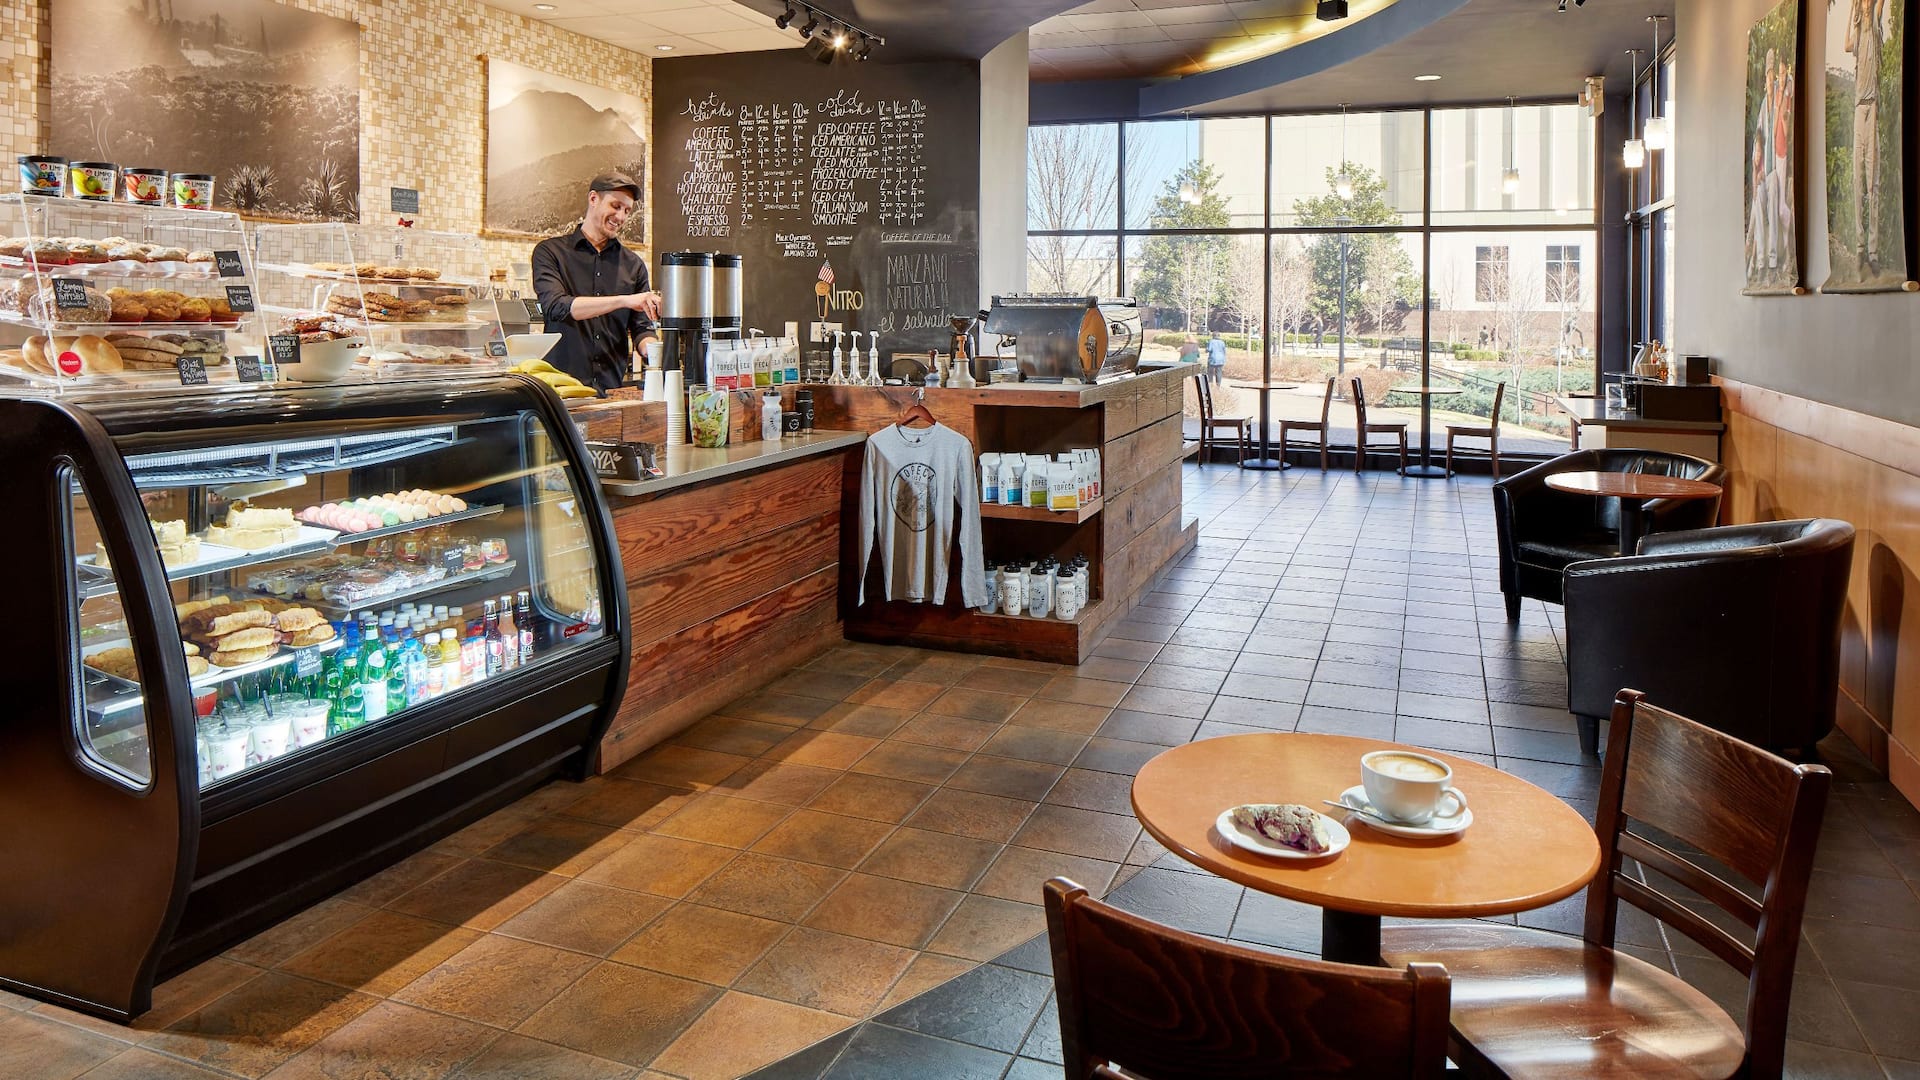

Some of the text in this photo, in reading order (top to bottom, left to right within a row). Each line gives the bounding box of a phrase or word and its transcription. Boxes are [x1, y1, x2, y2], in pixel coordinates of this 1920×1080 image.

[692, 126, 730, 139] COFFEE
[818, 123, 836, 135] ICED
[837, 122, 876, 134] COFFEE
[685, 138, 734, 151] AMERICANO
[811, 134, 827, 147] ICED
[830, 134, 876, 146] AMERICANO
[689, 150, 715, 162] LATTE
[810, 147, 830, 157] ICED
[830, 147, 856, 157] LATTE
[694, 160, 723, 172] MOCHA
[816, 157, 836, 168] ICED
[839, 157, 868, 168] MOCHA
[683, 171, 734, 184] CAPPUCCINO
[811, 168, 846, 180] FROZEN
[847, 167, 879, 179] COFFEE
[677, 183, 693, 194] HOT
[694, 183, 737, 193] CHOCOLATE
[812, 180, 833, 190] ICED
[834, 180, 854, 190] TEA
[681, 194, 703, 205] CHAI
[704, 193, 733, 204] LATTE
[811, 192, 831, 202] ICED
[832, 192, 855, 202] CHAI
[682, 204, 726, 215] MACCHIATO
[812, 202, 846, 213] ITALIAN
[849, 201, 868, 213] SODA
[687, 214, 729, 226] ESPRESSO
[812, 213, 858, 225] SMOOTHIE
[687, 226, 730, 237] POUR OVER
[881, 231, 909, 241] COFFEE
[912, 233, 922, 241] OF
[922, 233, 936, 241] THE
[886, 253, 948, 285] MANZANO
